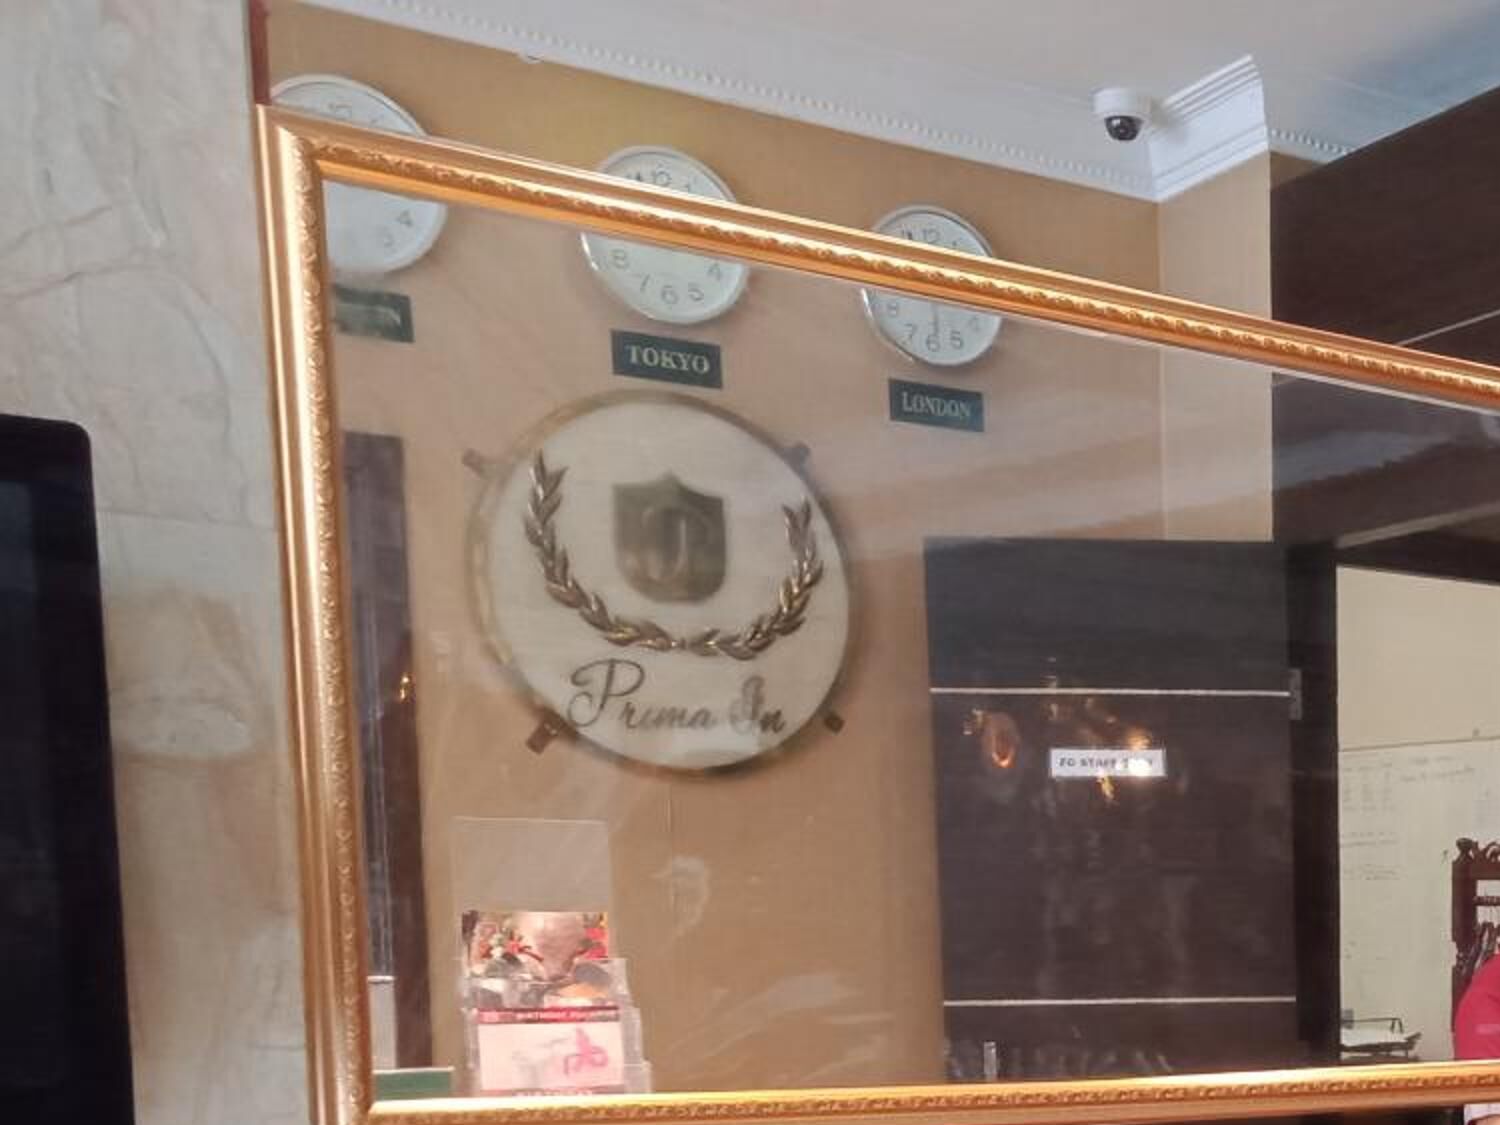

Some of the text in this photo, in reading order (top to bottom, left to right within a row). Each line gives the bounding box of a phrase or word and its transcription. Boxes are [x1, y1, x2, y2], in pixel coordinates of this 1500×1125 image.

[611, 249, 630, 269] 8
[660, 285, 679, 305] 6
[950, 330, 965, 349] 5
[625, 344, 711, 374] TOKYO
[901, 391, 972, 420] LONDON
